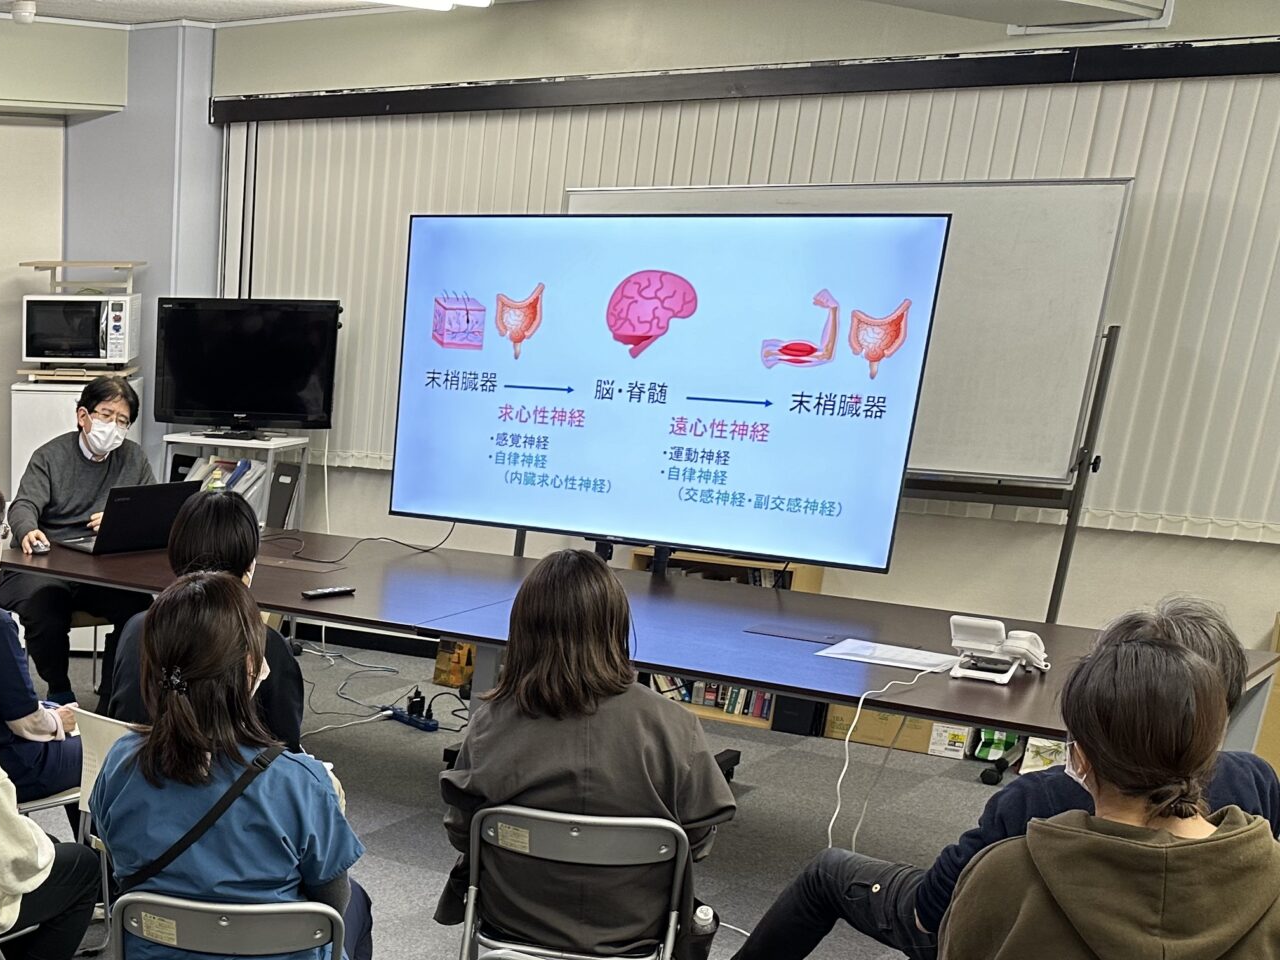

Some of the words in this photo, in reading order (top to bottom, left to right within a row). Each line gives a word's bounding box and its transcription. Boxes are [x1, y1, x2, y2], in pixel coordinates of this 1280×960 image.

[425, 368, 498, 393] 末梢臓器
[594, 379, 669, 405] 脳・脊髄
[498, 403, 586, 428] 求心性神経
[789, 391, 887, 419] 末梢臓器
[669, 416, 770, 443] 遠心性神経
